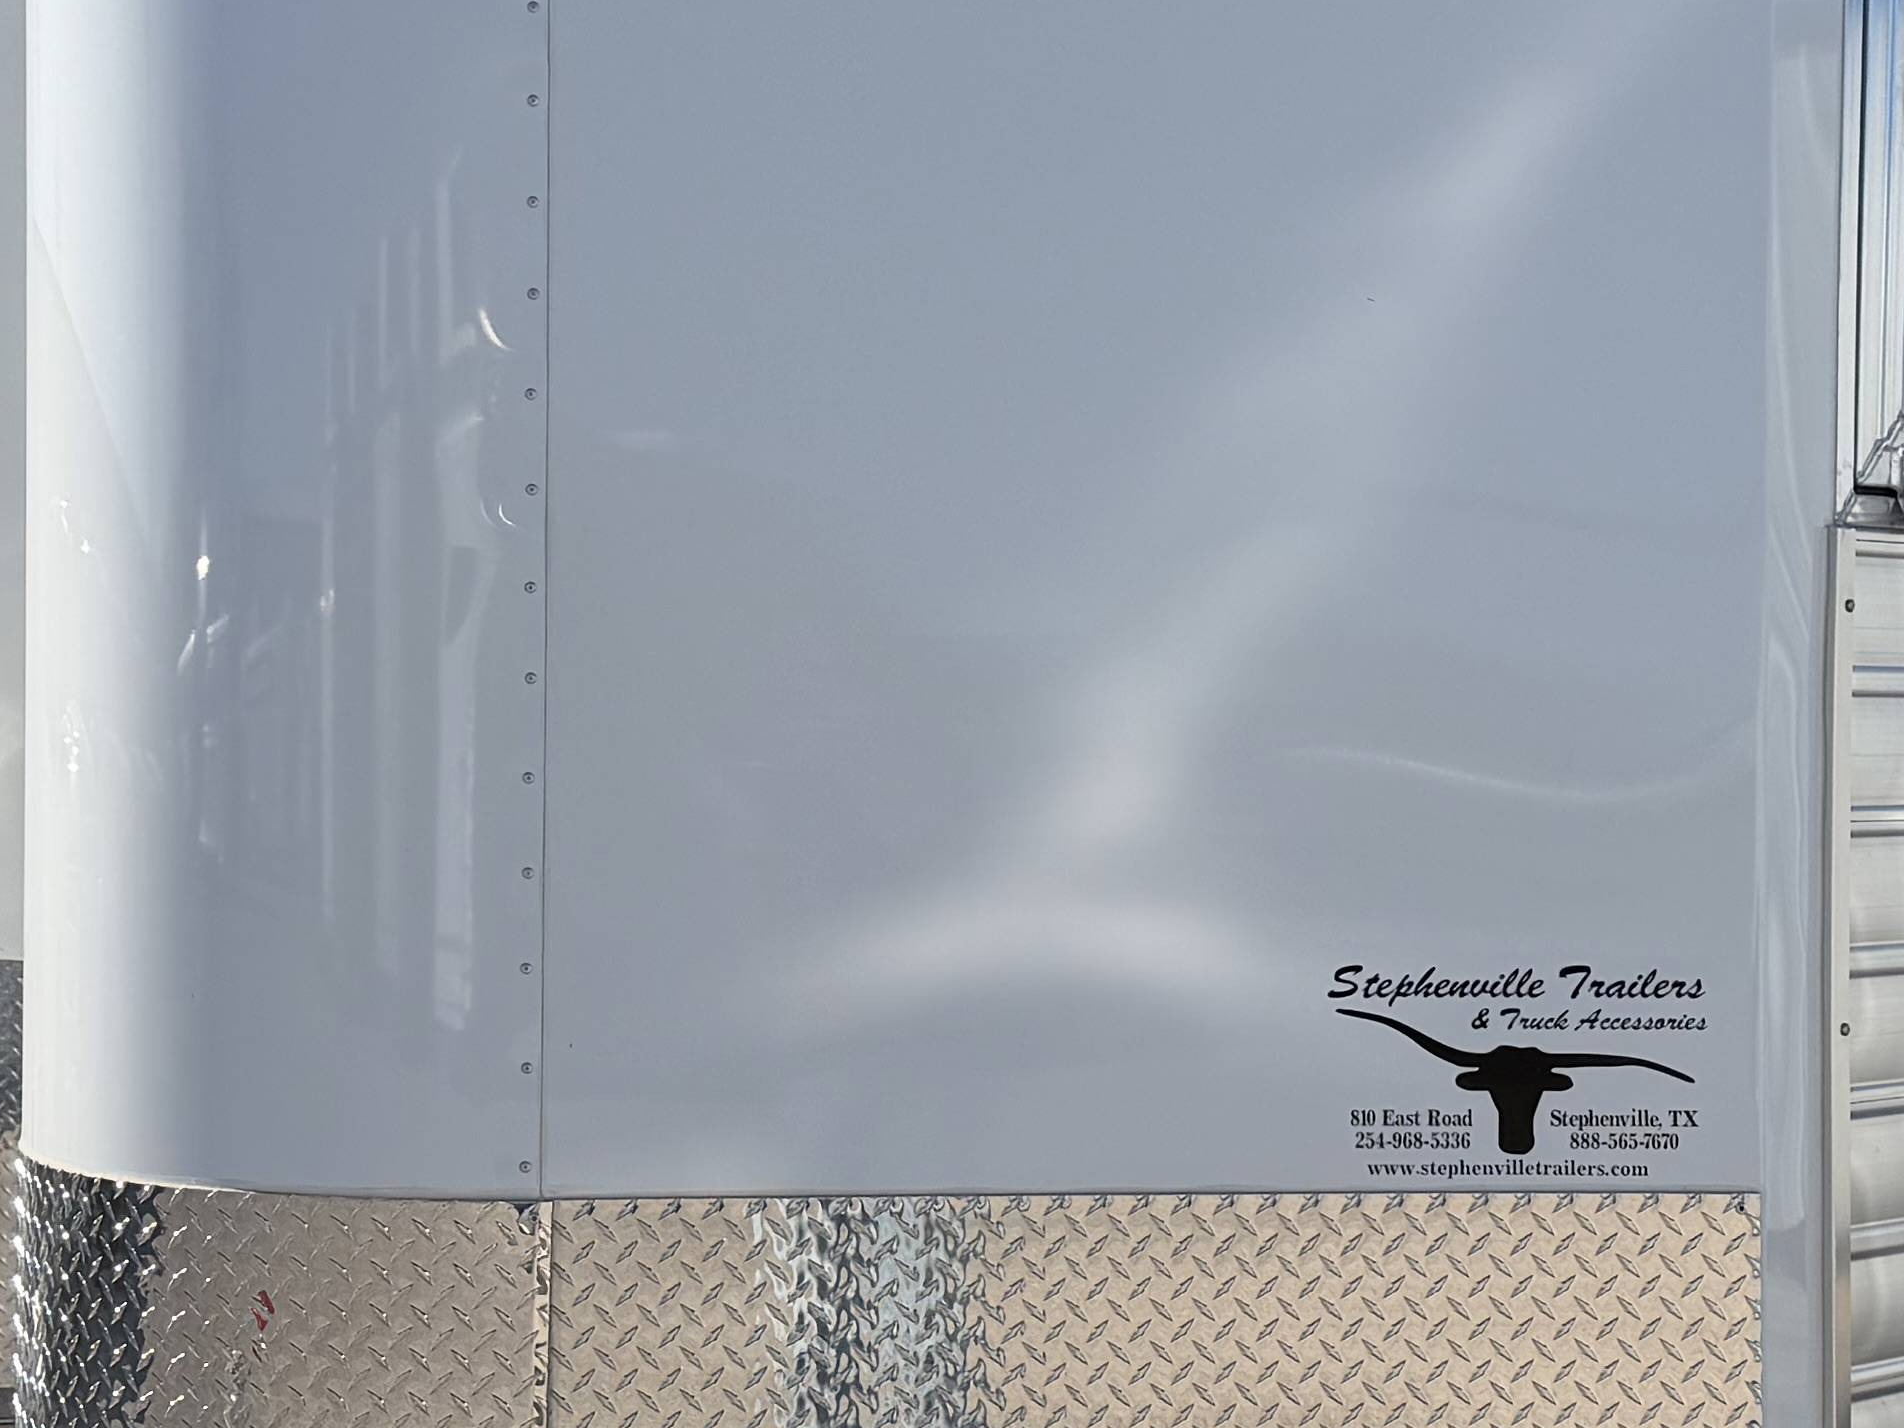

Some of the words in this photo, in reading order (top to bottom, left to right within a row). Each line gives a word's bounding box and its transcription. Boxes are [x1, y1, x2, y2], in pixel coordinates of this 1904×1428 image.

[1327, 964, 1545, 1007] Stephenville
[1559, 965, 1705, 1001] Trailers
[1471, 1008, 1489, 1030] &
[1500, 1009, 1570, 1031] Truck
[1575, 1009, 1708, 1031] Accessories
[1350, 1110, 1375, 1127] 810
[1383, 1110, 1421, 1127] East
[1428, 1109, 1473, 1127] Road
[1550, 1109, 1662, 1131] Stephenville,
[1668, 1110, 1698, 1128] TX
[1354, 1132, 1471, 1150] 254-968-5336
[1570, 1132, 1679, 1150] 888-565-7670
[1367, 1159, 1649, 1179] www.stephenvilletrailers.com
